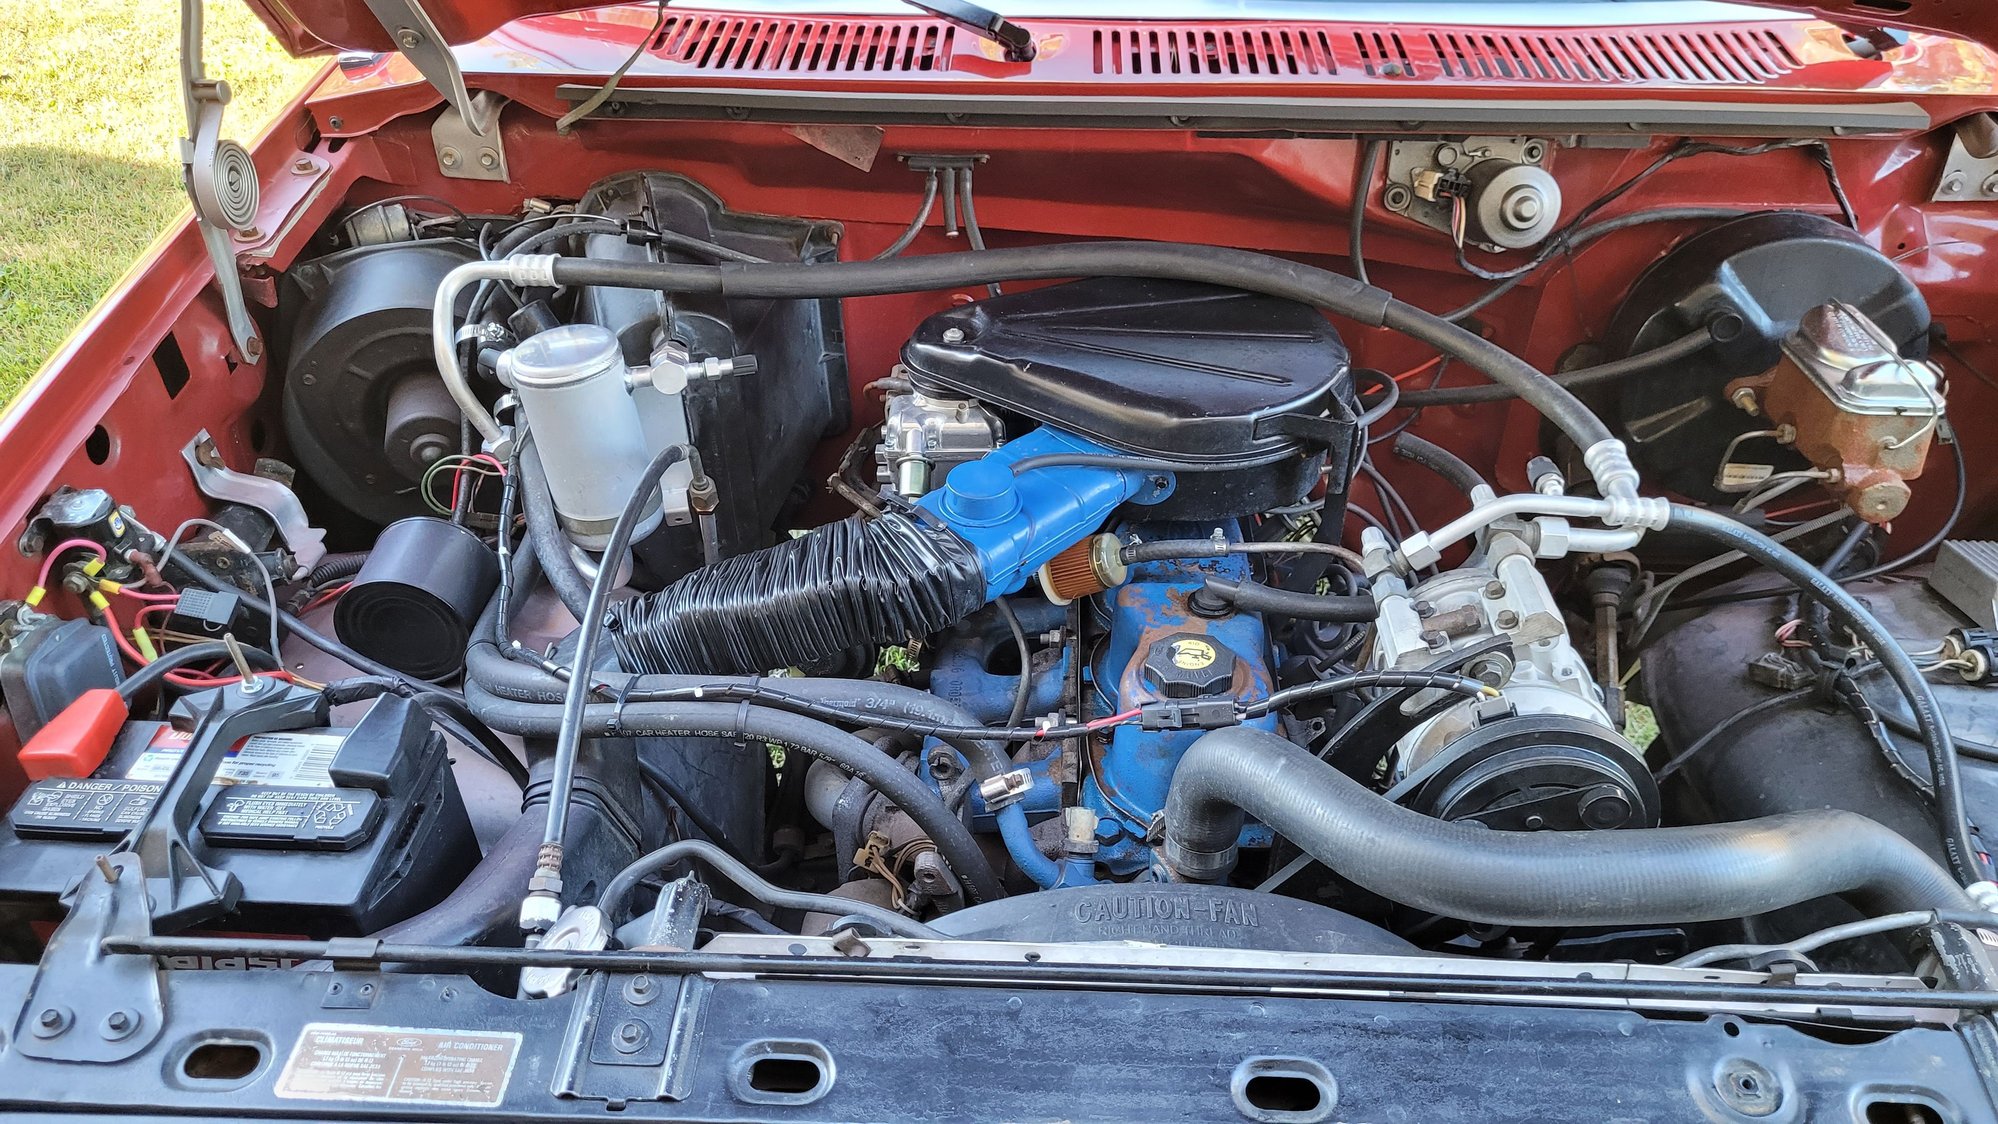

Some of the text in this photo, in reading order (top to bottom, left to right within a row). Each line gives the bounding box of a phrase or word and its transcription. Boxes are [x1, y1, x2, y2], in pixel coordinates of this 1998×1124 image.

[494, 684, 533, 700] HEATER
[864, 697, 896, 710] 3/4"
[635, 729, 654, 737] CAR
[655, 729, 691, 737] HEATER
[800, 746, 818, 757] BAR
[68, 781, 114, 791] DANGER
[122, 784, 163, 793] POISON
[438, 1040, 505, 1052] AIR CONDITIONER
